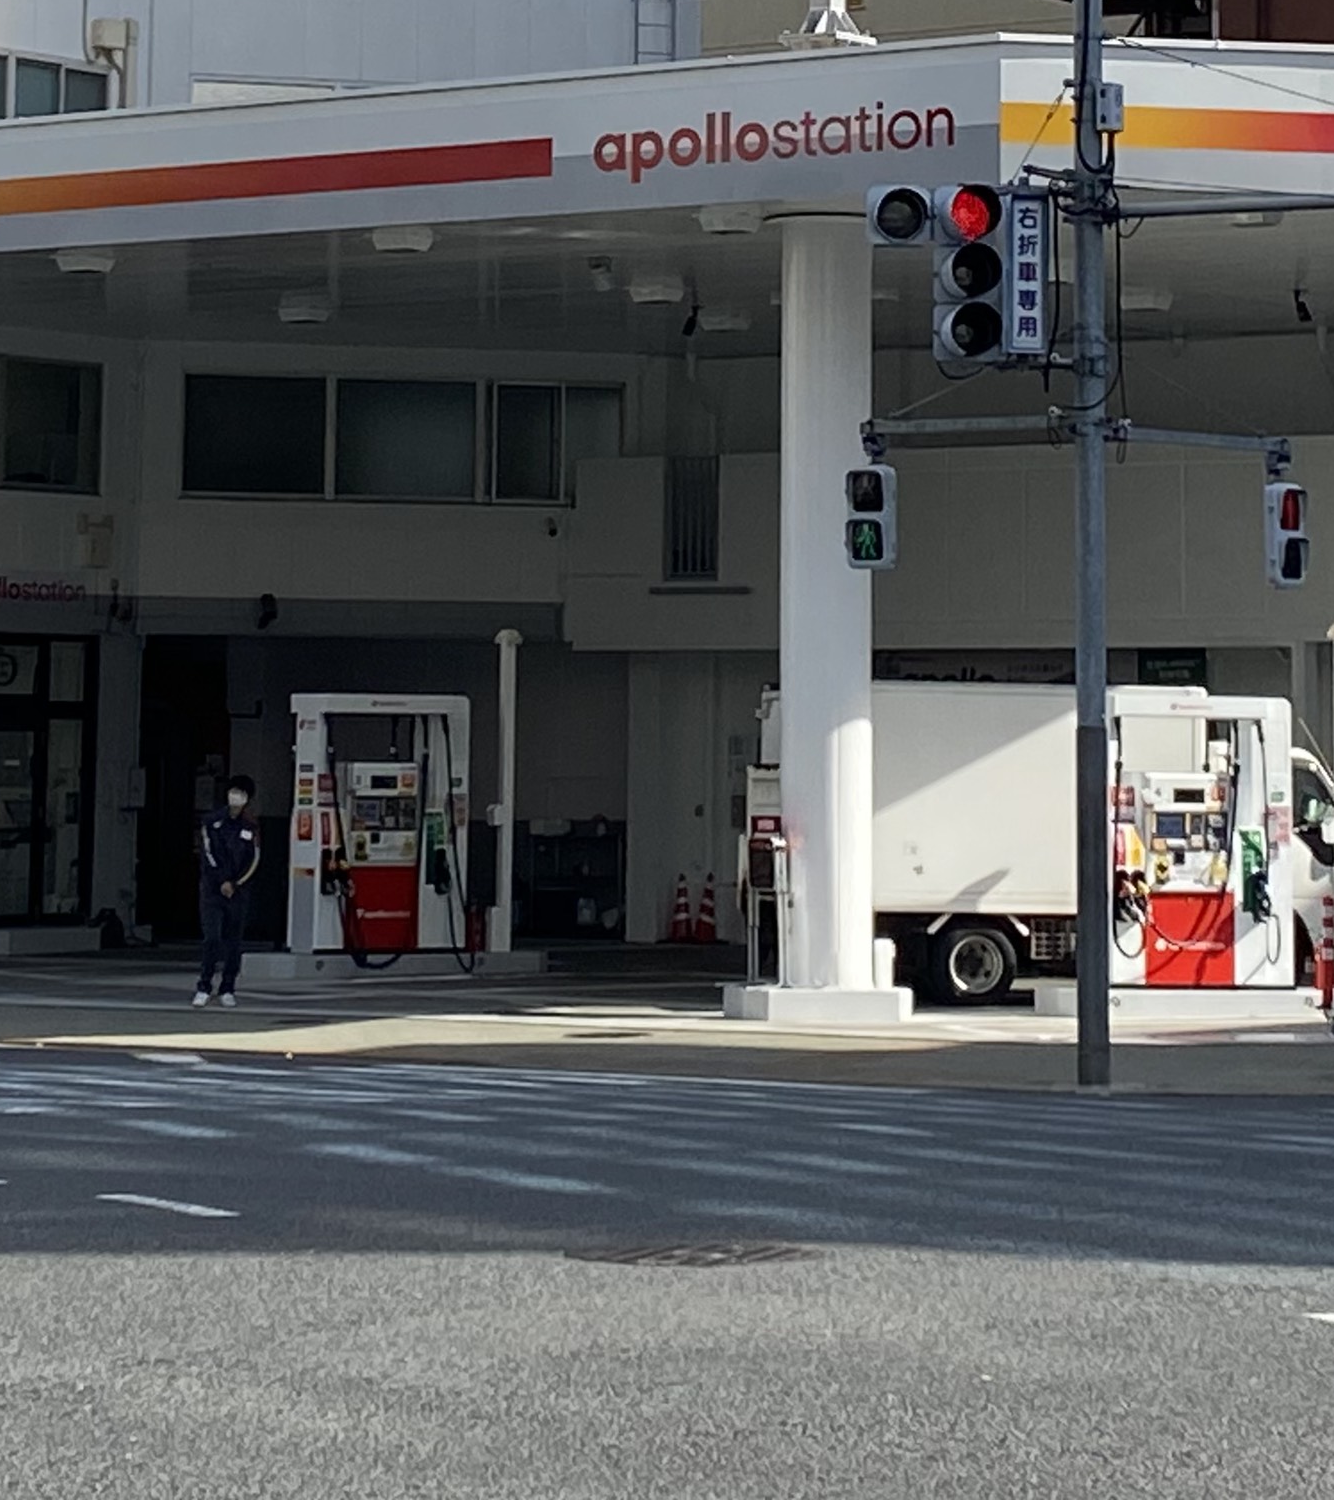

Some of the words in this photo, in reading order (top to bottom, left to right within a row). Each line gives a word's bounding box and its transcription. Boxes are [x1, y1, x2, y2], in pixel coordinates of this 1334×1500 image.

[593, 101, 956, 184] apollostation
[1016, 205, 1039, 339] 右折車専用
